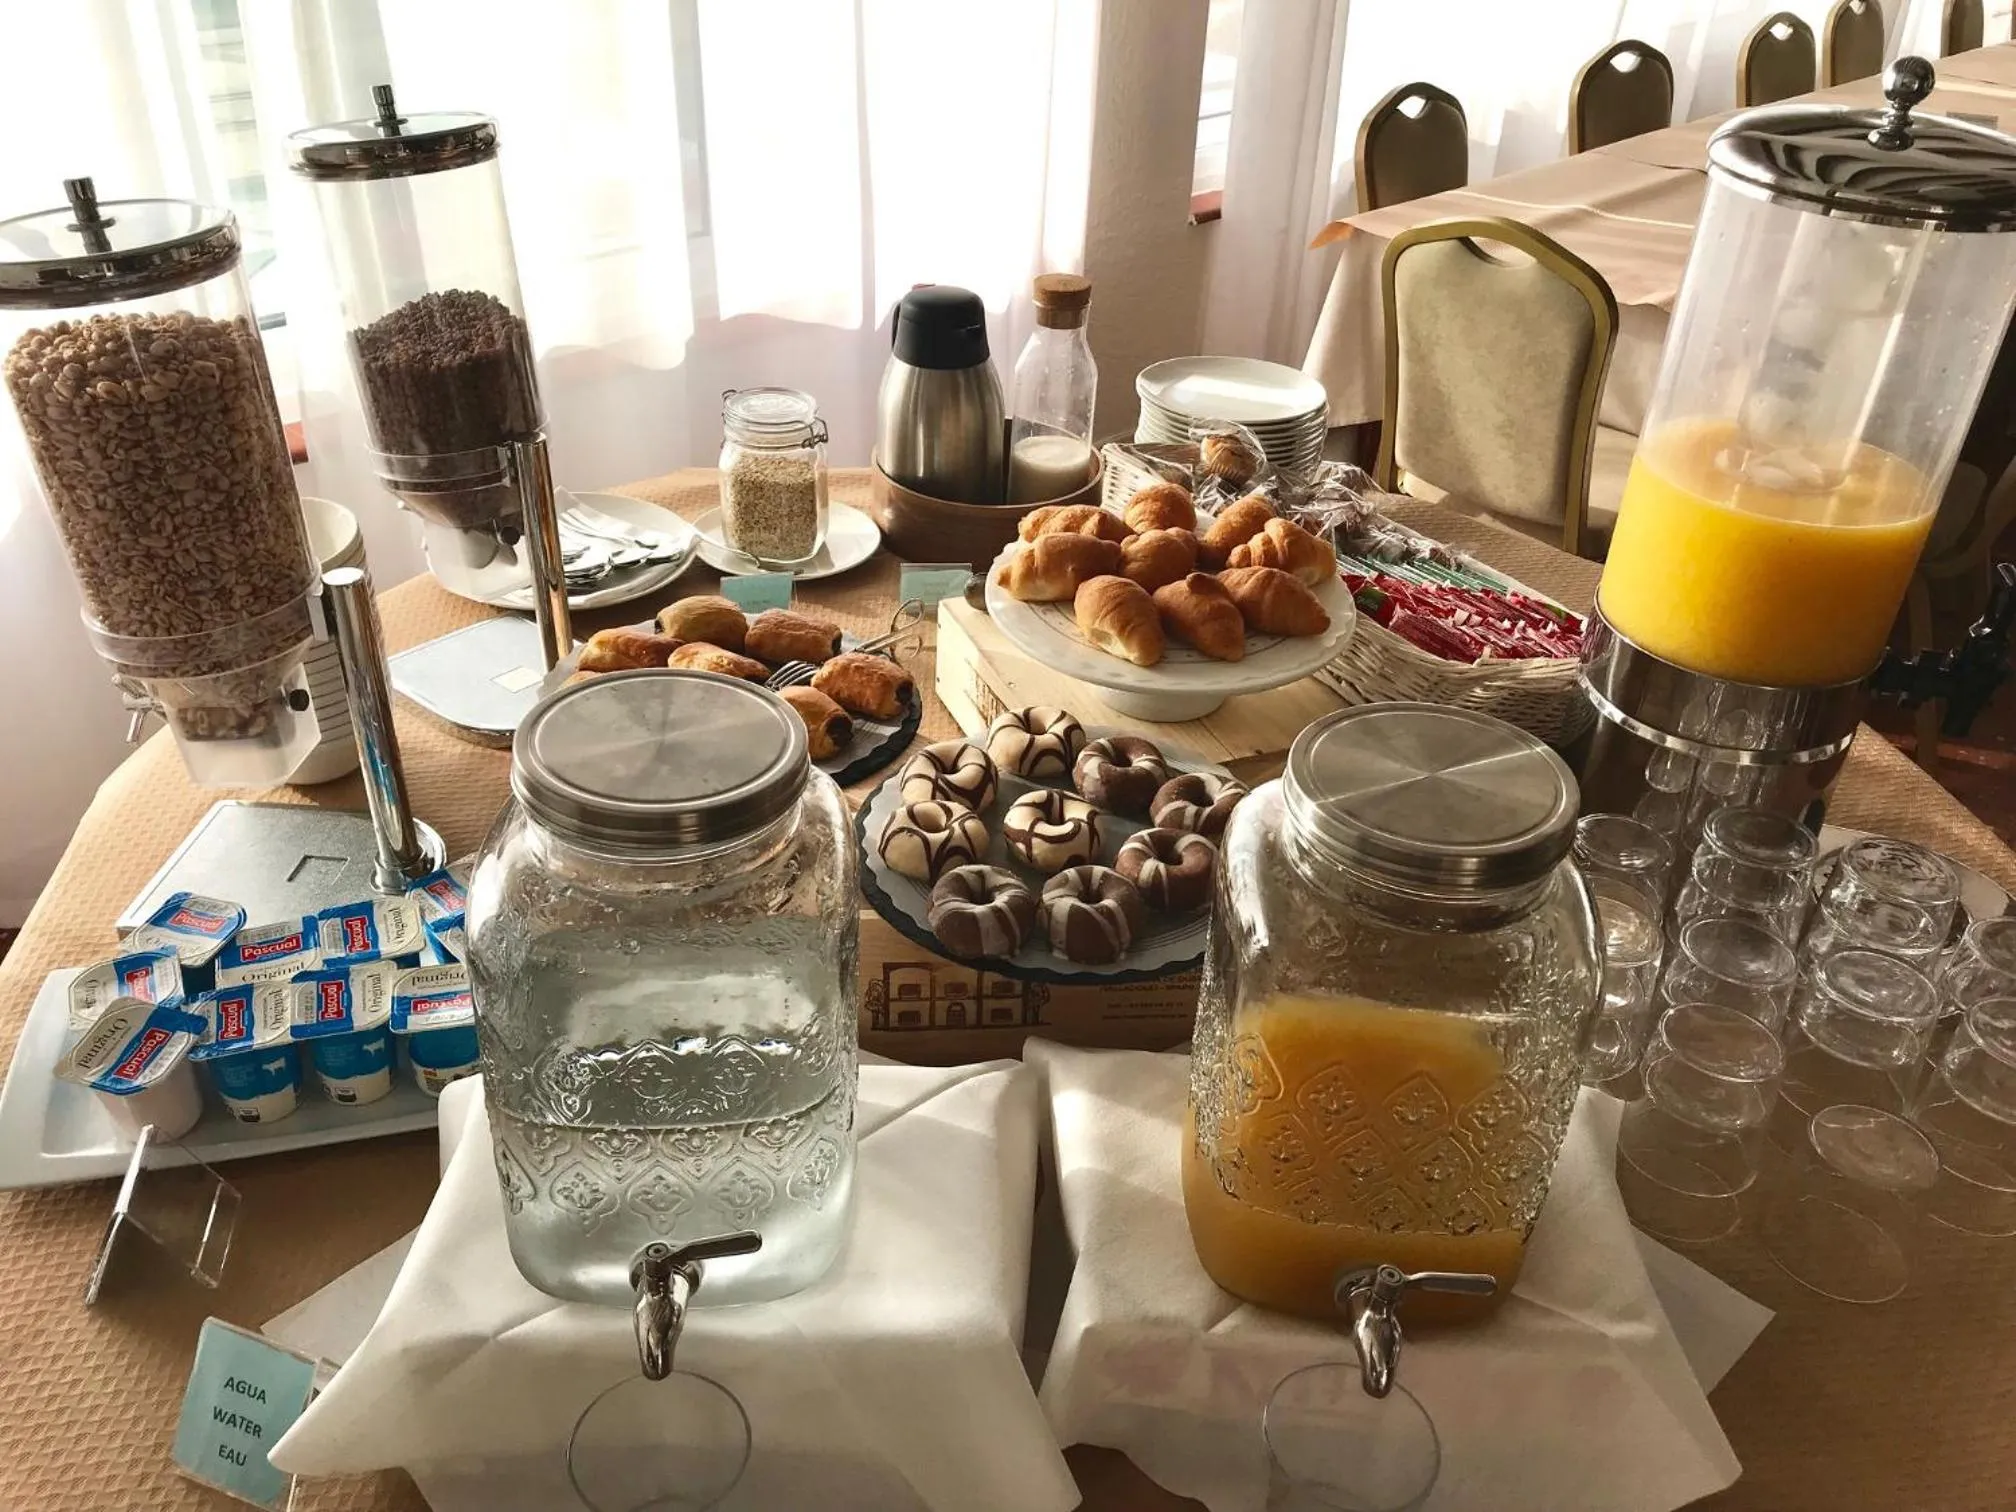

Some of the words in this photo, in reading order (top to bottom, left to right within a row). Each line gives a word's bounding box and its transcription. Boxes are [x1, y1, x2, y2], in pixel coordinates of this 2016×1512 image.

[244, 938, 297, 957] Pascual
[352, 920, 364, 952] Pascual
[242, 962, 304, 981] Original
[324, 984, 337, 1018] Pascual
[367, 973, 383, 1013] Original
[417, 998, 470, 1011] Pascual
[224, 1003, 238, 1037] Pascual
[269, 989, 287, 1030] Original
[78, 1018, 128, 1069] Original
[123, 1032, 165, 1075] Pascual
[224, 1377, 267, 1404] AGUA
[213, 1406, 262, 1438] WATER
[218, 1444, 247, 1467] EAU
